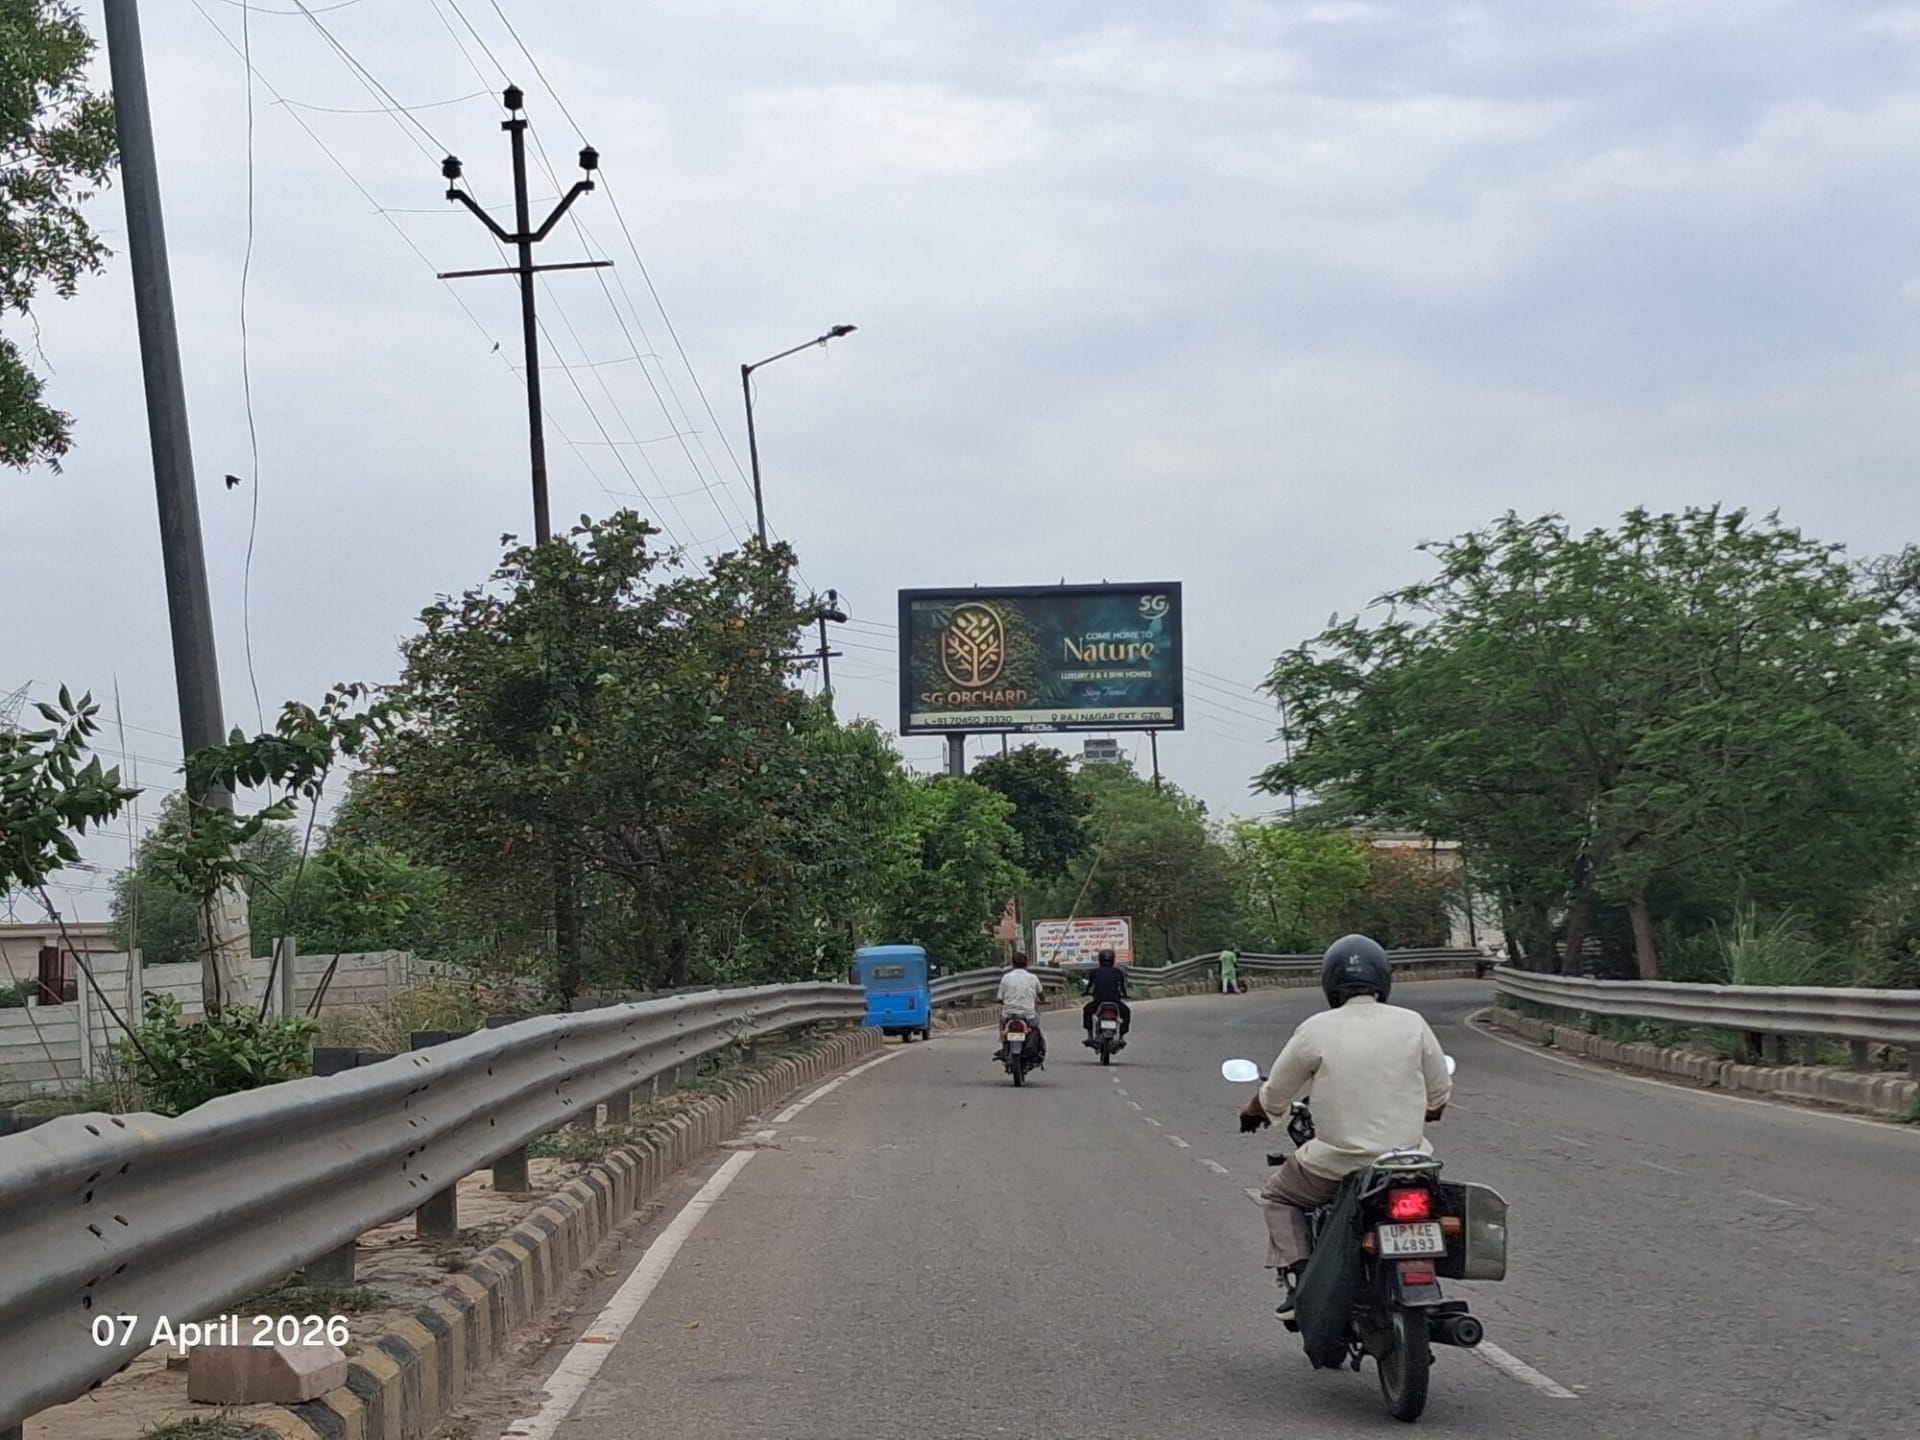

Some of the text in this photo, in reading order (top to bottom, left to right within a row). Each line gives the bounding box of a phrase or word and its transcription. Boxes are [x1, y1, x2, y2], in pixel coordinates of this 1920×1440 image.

[1138, 595, 1167, 611] SG
[1085, 630, 1154, 640] COME HOME TO
[1063, 636, 1155, 662] Nature
[1060, 671, 1088, 680] LUXURY
[1125, 670, 1152, 678] HOMES
[921, 689, 1027, 705] SG ORCHARD
[1081, 712, 1115, 721] NAGAR
